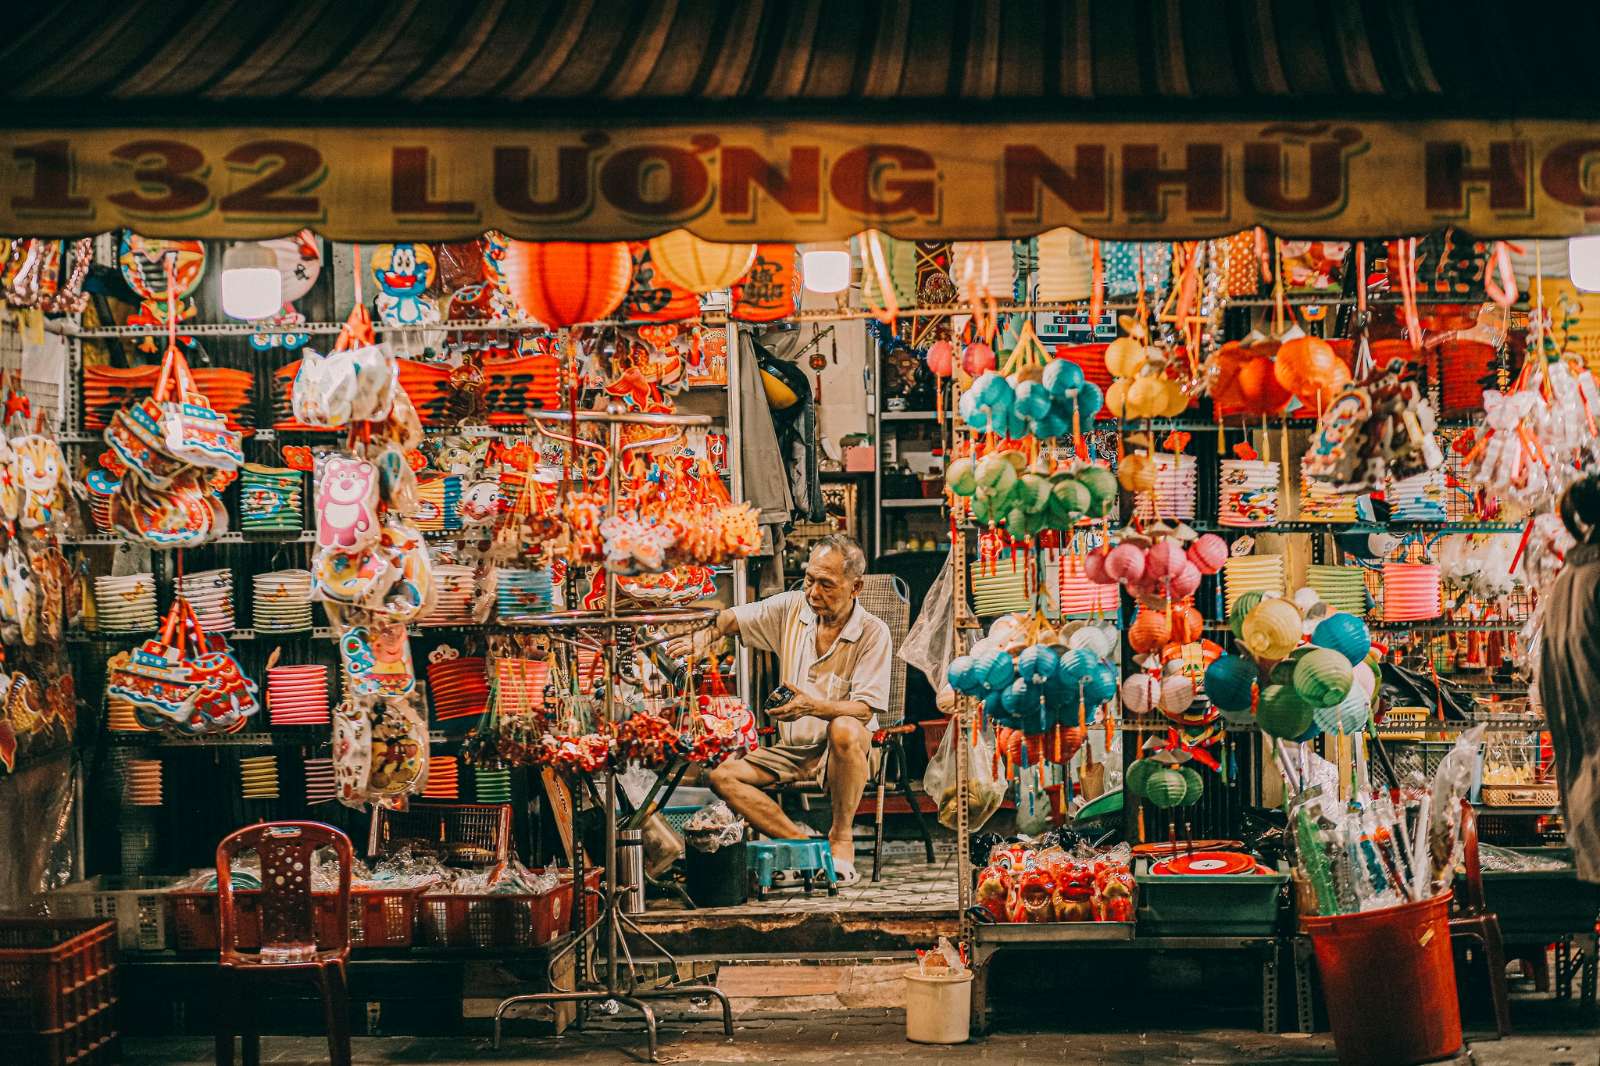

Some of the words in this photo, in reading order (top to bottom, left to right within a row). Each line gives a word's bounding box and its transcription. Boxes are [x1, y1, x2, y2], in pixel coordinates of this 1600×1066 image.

[11, 139, 326, 222] 132
[391, 130, 943, 224] LƯƠNG
[1003, 123, 1369, 222] NHỮ
